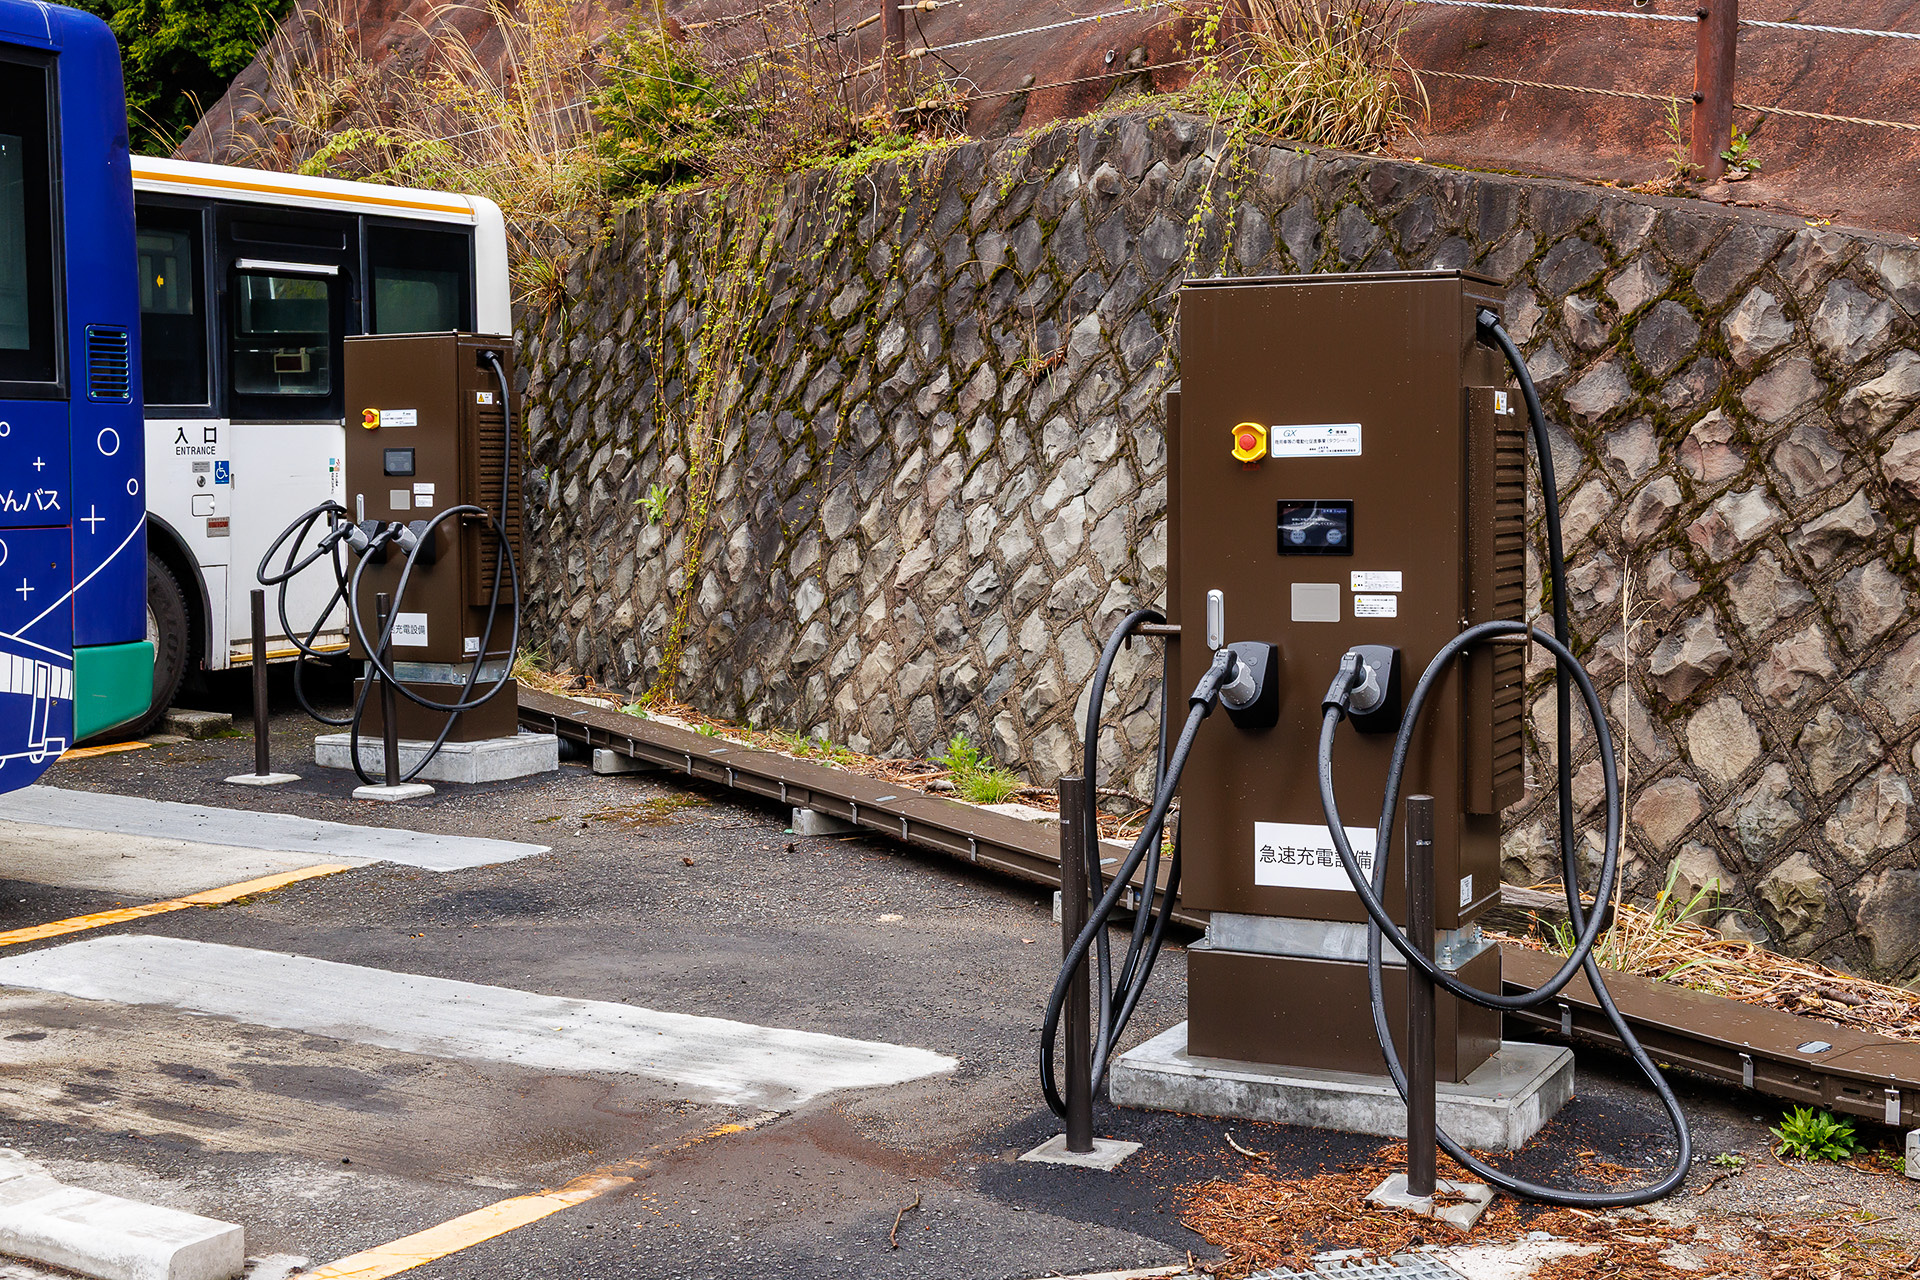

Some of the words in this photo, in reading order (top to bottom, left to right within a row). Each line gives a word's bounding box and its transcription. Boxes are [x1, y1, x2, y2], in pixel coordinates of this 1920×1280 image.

[175, 427, 217, 444] 入口
[175, 446, 216, 455] ENTRANCE
[0, 488, 61, 512] んバス
